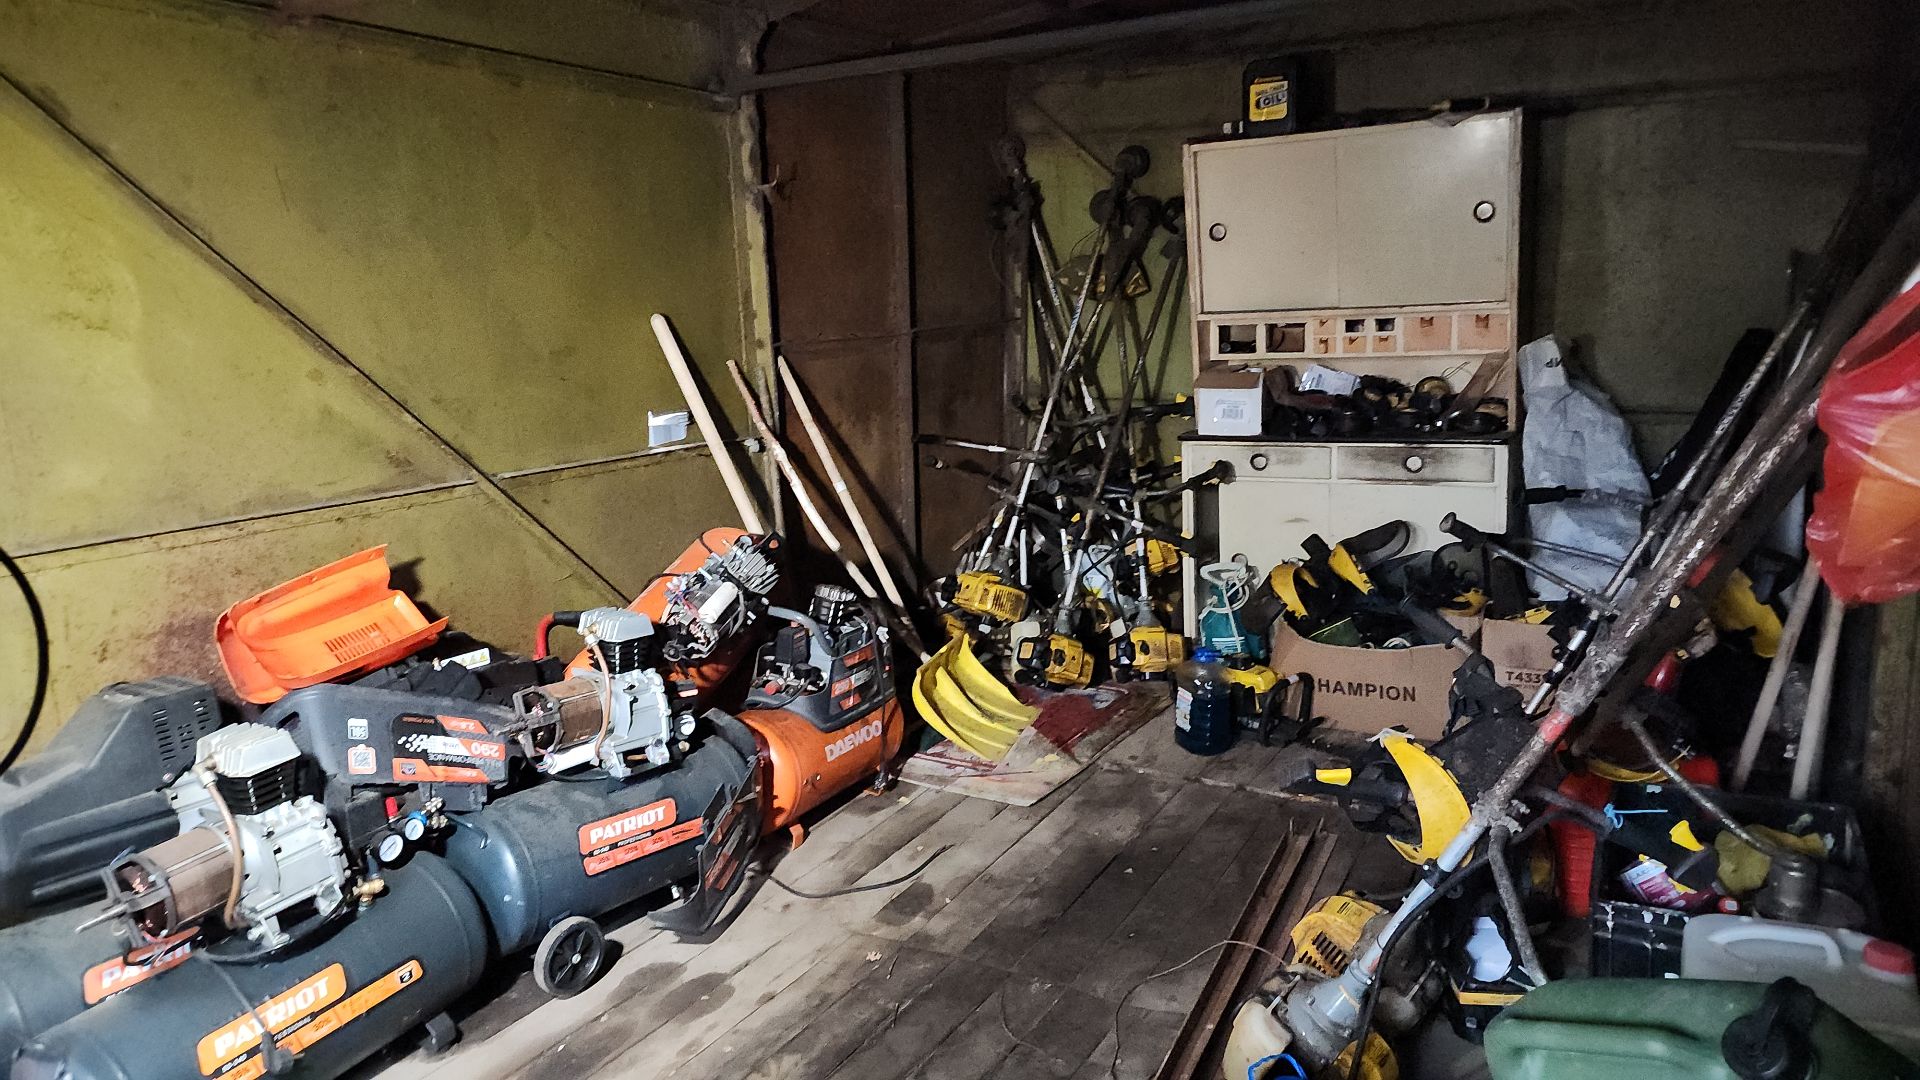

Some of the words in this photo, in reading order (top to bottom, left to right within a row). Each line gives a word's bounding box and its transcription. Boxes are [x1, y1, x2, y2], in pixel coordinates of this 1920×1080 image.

[1317, 677, 1416, 702] HAMPION
[1505, 671, 1543, 684] T433
[824, 719, 883, 762] DAEWOO
[590, 805, 666, 845] PATRIOT
[213, 975, 330, 1059] PATRIOT
